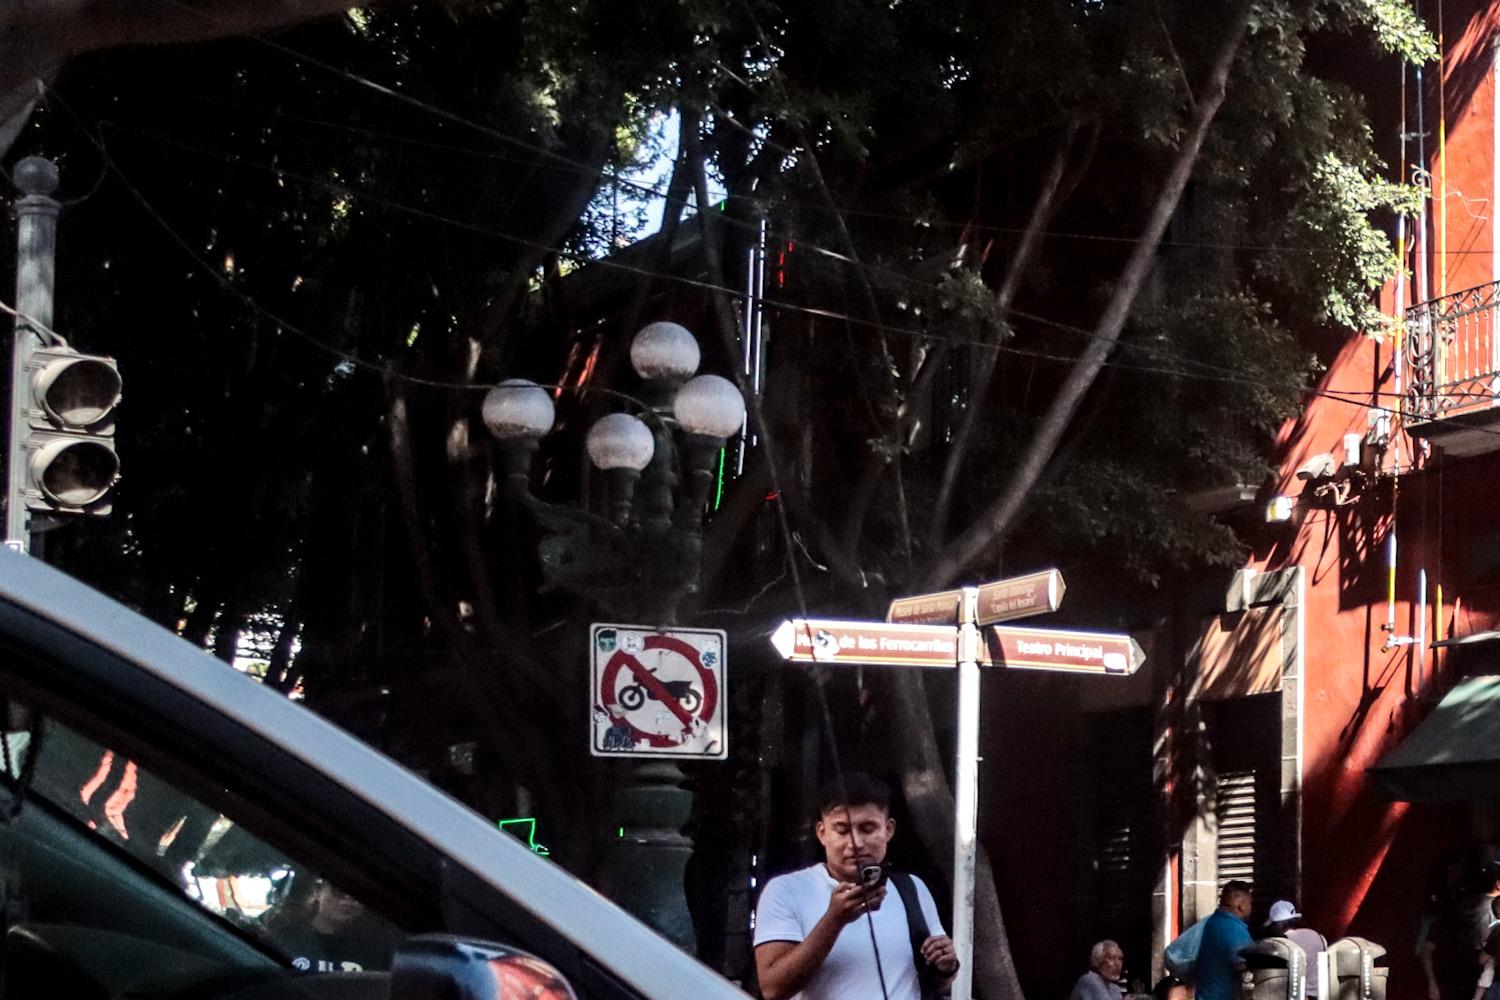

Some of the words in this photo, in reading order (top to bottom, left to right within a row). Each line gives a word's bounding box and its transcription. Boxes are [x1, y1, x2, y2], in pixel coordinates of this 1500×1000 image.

[839, 634, 855, 648] de
[859, 636, 877, 650] los
[880, 637, 954, 653] Ferrocarriles
[1016, 640, 1052, 655] Teatro
[1055, 643, 1103, 661] Principal
